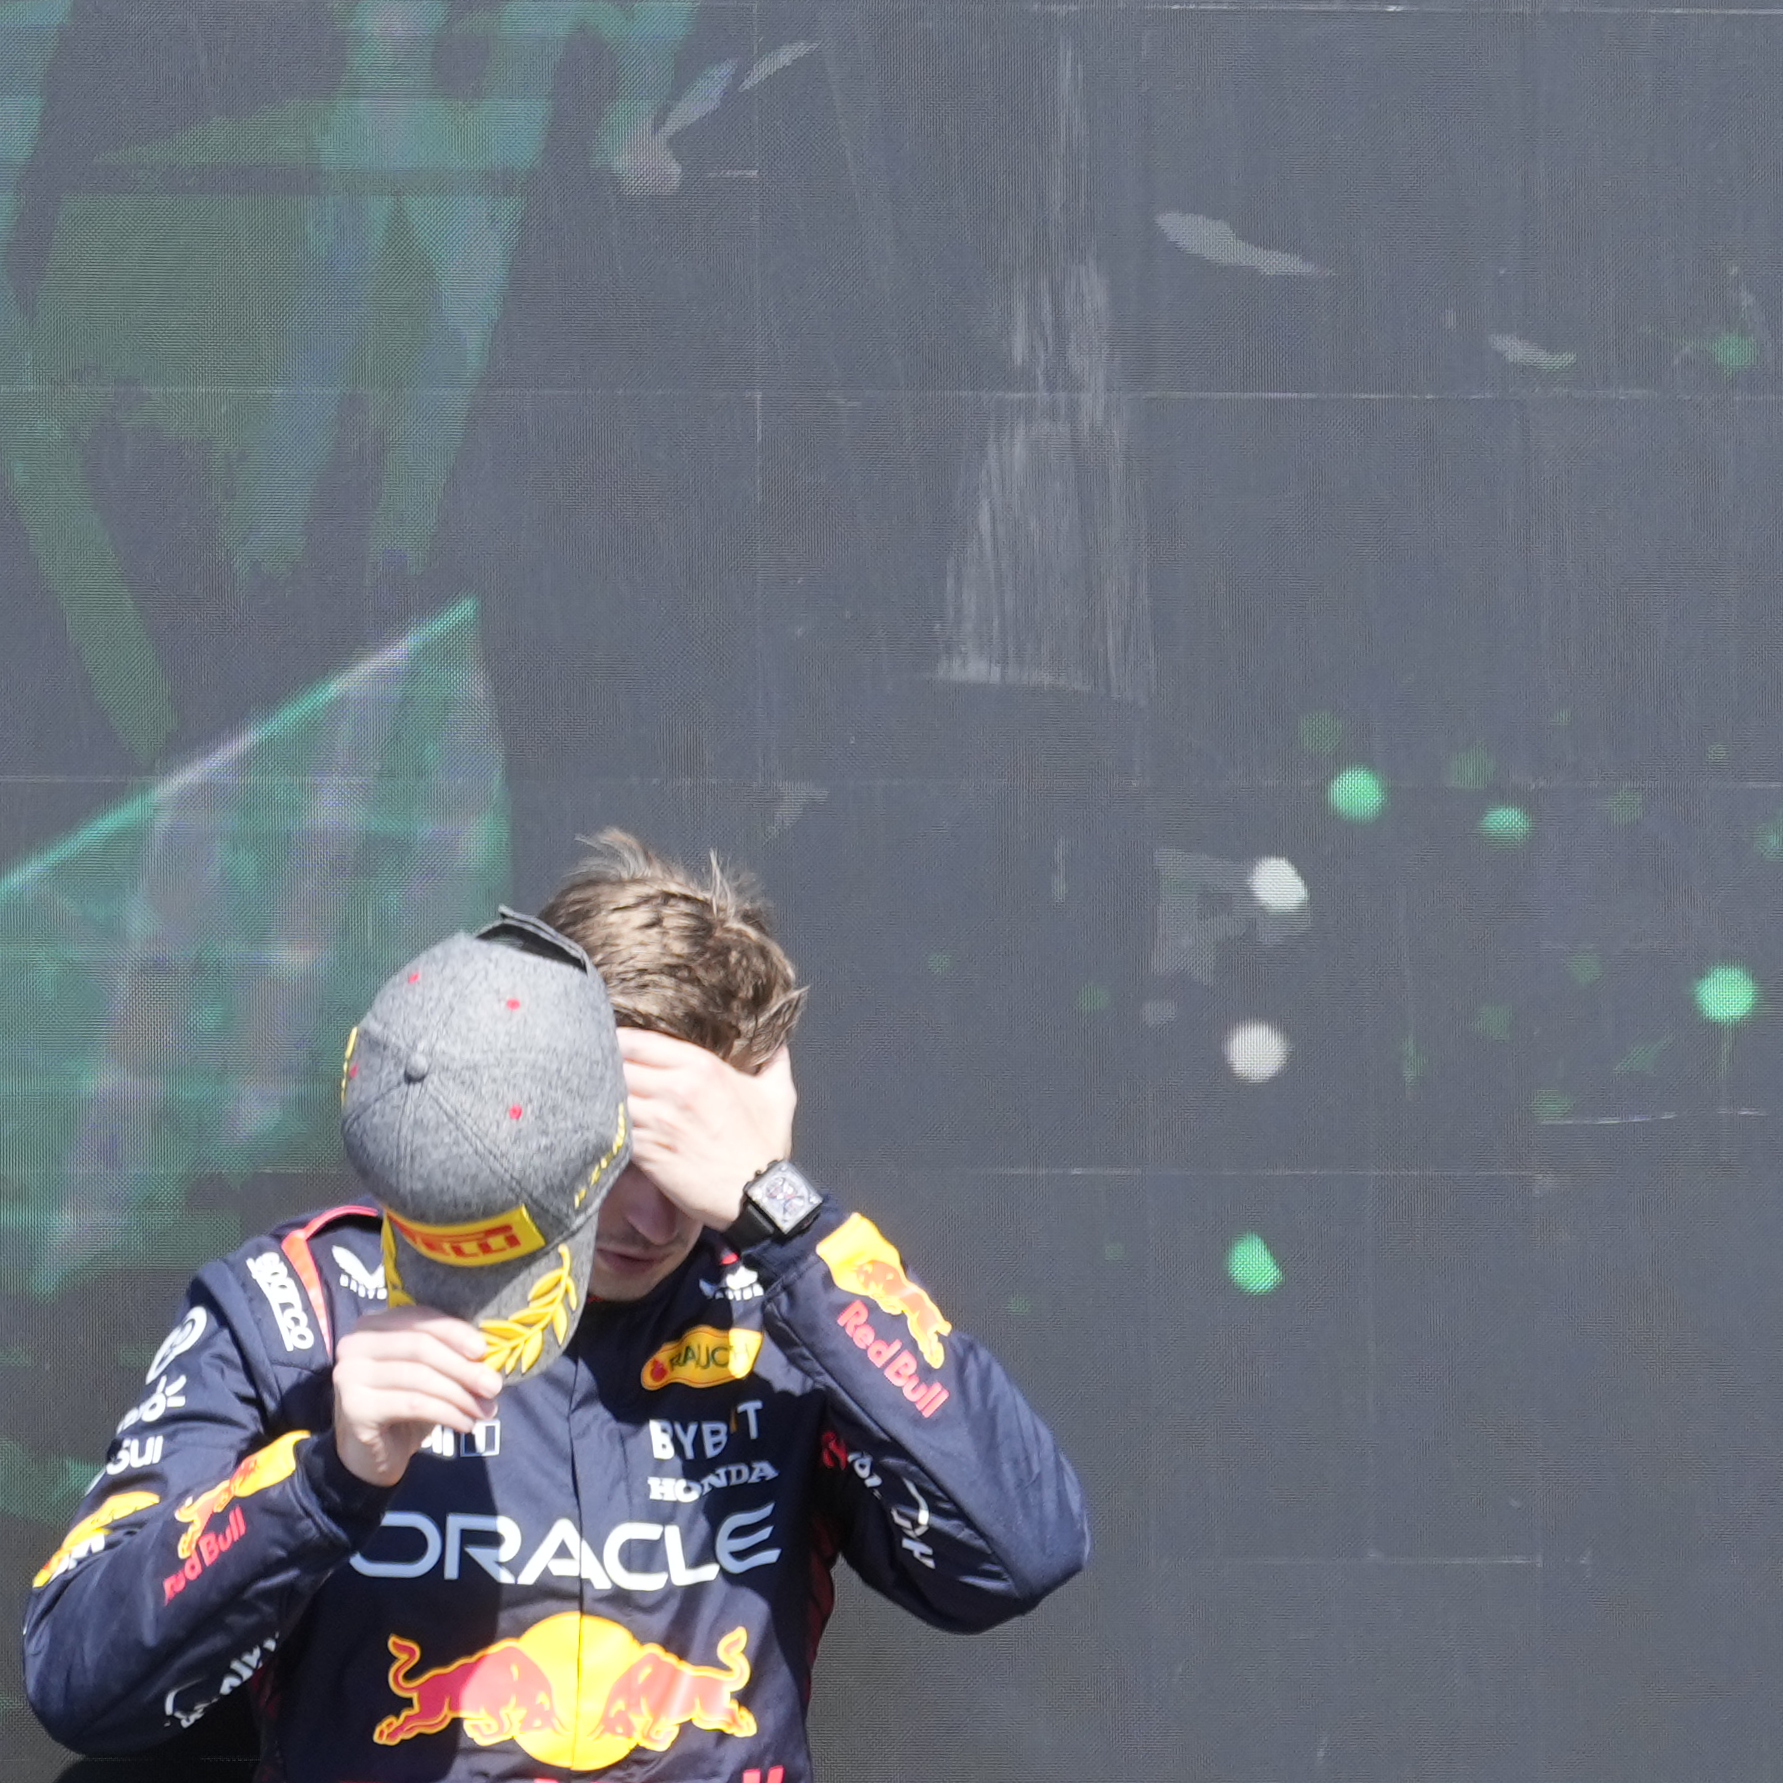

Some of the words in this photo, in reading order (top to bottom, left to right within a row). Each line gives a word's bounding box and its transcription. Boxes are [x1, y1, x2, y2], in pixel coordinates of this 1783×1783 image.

[837, 1300, 902, 1368] Red
[884, 1350, 950, 1418] Bull
[647, 1461, 780, 1503] HONDA
[198, 1504, 246, 1567] Bull
[350, 1502, 782, 1592] ORACLE
